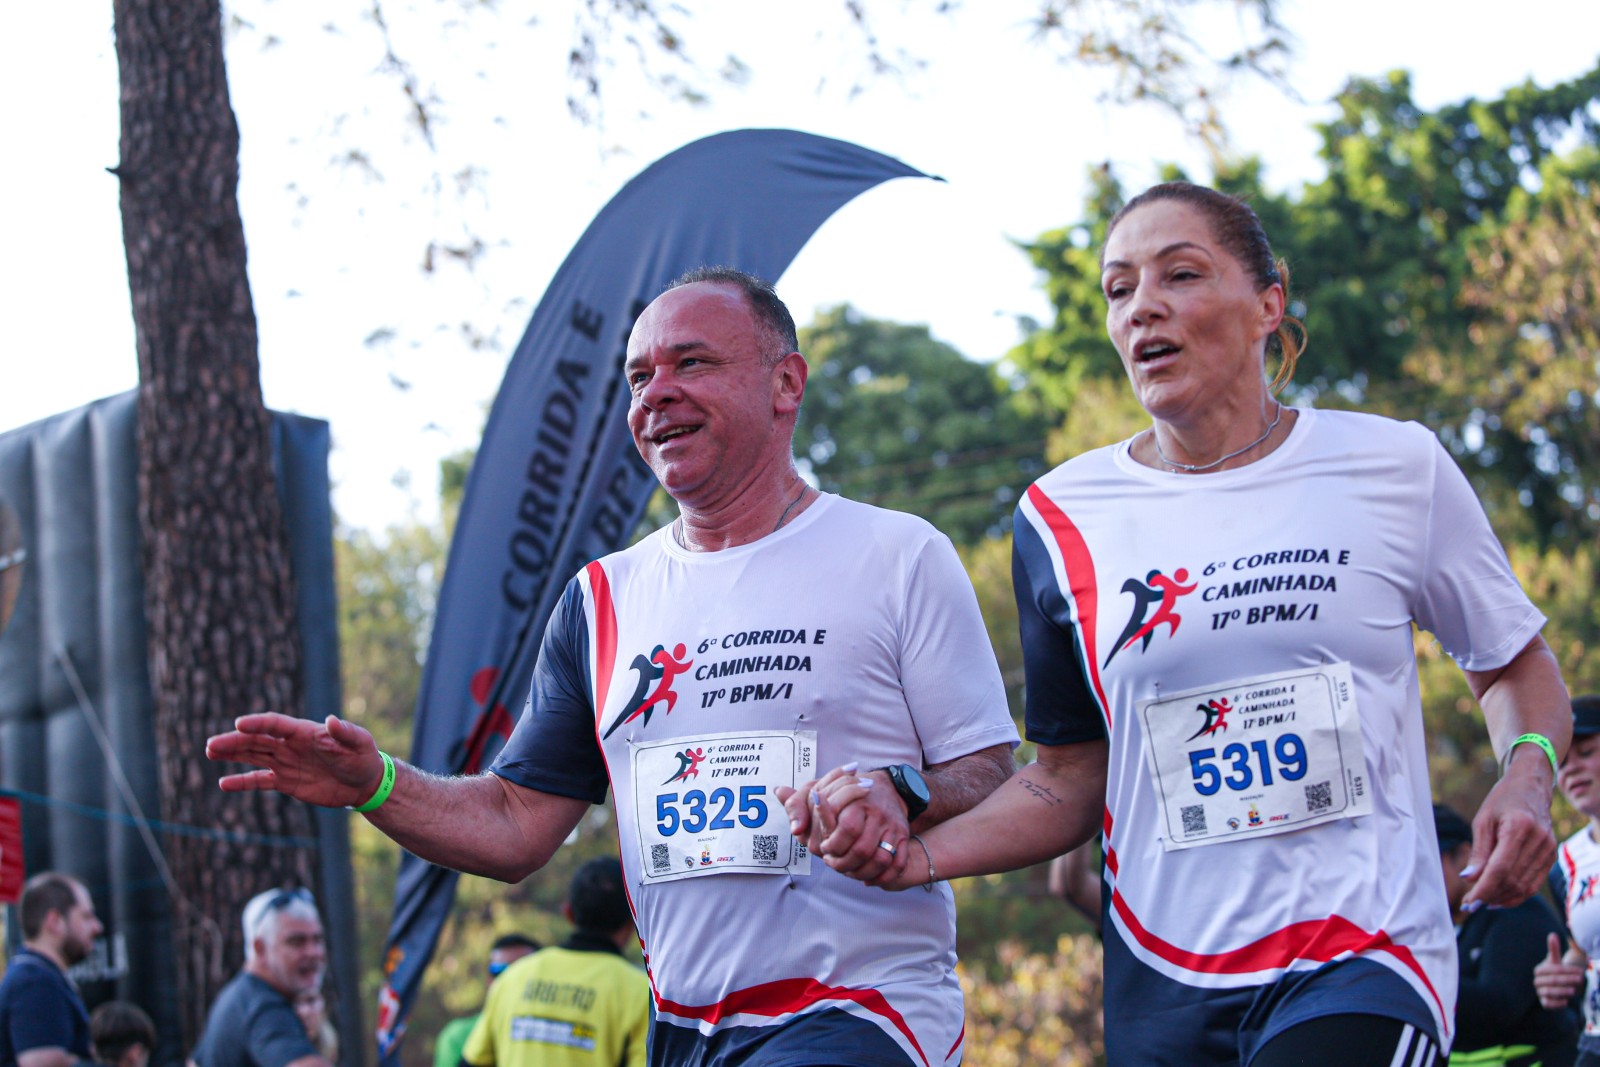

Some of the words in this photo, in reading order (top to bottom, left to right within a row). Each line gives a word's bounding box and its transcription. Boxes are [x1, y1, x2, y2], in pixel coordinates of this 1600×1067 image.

[502, 357, 593, 613] CORRIDA
[571, 300, 605, 342] E
[1232, 549, 1330, 571] CORRIDA
[1337, 550, 1350, 565] E
[1202, 574, 1337, 602] CAMINHADA
[1211, 609, 1241, 631] 17º
[1246, 603, 1319, 625] BPM/I
[721, 629, 806, 649] CORRIDA
[813, 629, 827, 645] E
[695, 655, 812, 681] CAMINHADA
[701, 688, 726, 708] 17º
[729, 683, 793, 704] BPM/I
[1245, 686, 1287, 700] CORRIDA
[1290, 684, 1296, 693] E
[1339, 681, 1349, 702] 5319
[1238, 698, 1295, 714] CAMINHADA
[1258, 711, 1296, 727] BPM/I
[718, 743, 755, 752] CORRIDA
[709, 754, 760, 764] CAMINHADA
[1187, 733, 1308, 796] 5319
[724, 766, 760, 777] BPM/I
[1353, 776, 1364, 796] 5319
[656, 785, 769, 837] 5325
[799, 842, 808, 859] 325
